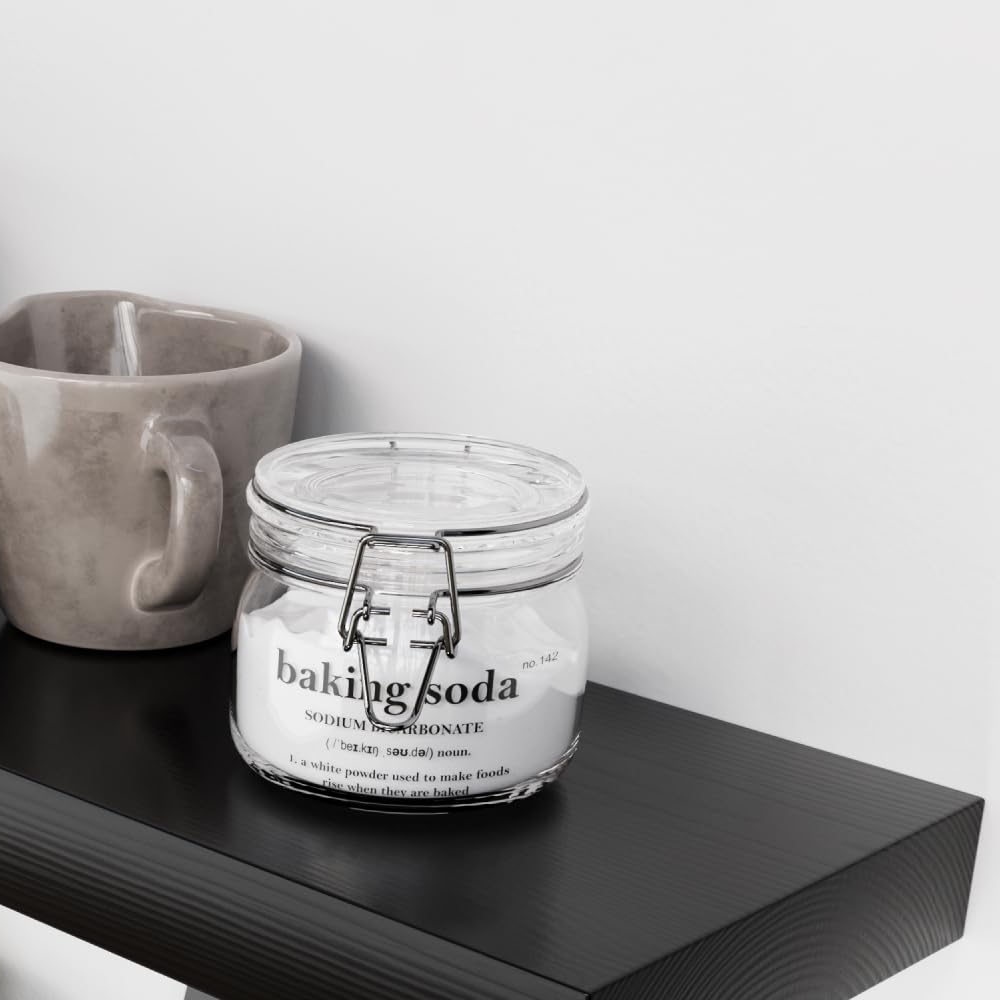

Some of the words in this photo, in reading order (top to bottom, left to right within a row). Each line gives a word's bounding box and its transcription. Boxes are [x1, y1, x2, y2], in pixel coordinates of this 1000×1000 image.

[277, 648, 411, 716] baking
[424, 669, 519, 705] soda
[304, 709, 367, 731] SODIUM
[437, 749, 471, 757] noun.
[311, 761, 342, 774] white
[345, 769, 389, 781] powder
[392, 772, 419, 782] used
[424, 774, 436, 782] to
[440, 772, 472, 782] make
[476, 766, 510, 779] foods
[322, 778, 344, 789] rise
[347, 784, 377, 795] when
[381, 787, 407, 797] they
[411, 789, 429, 797] are
[434, 786, 469, 797] baked
